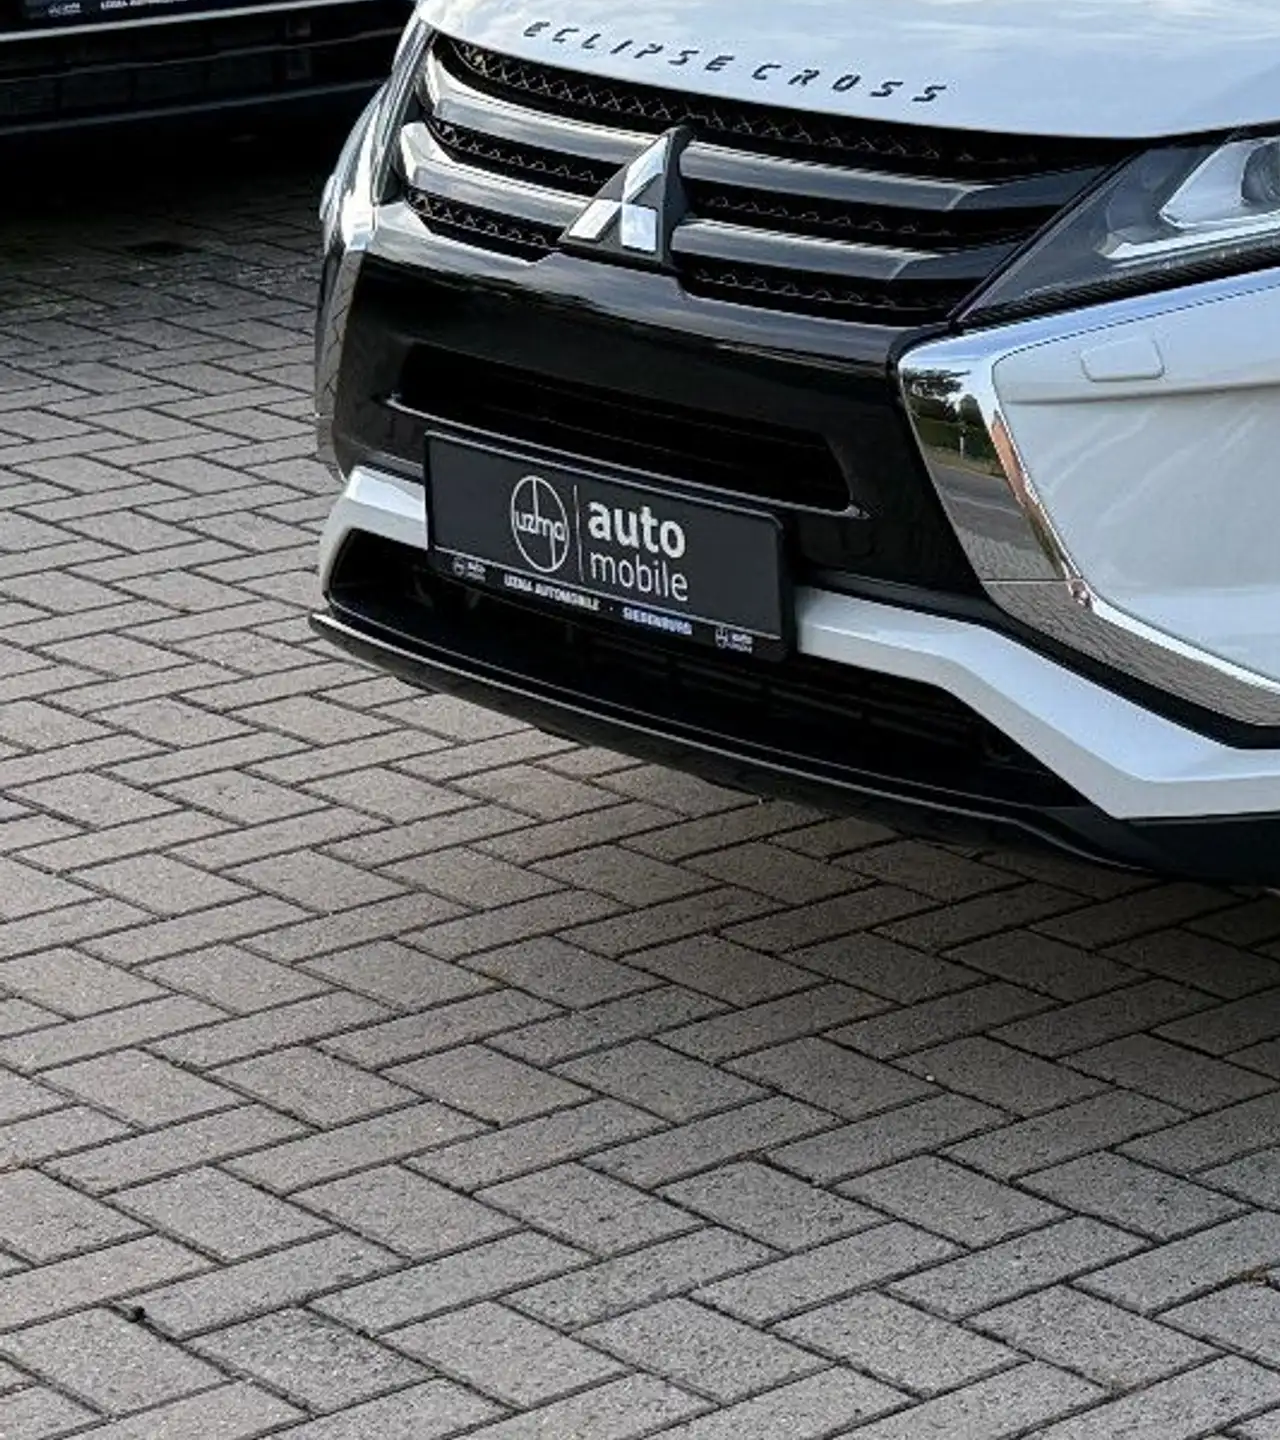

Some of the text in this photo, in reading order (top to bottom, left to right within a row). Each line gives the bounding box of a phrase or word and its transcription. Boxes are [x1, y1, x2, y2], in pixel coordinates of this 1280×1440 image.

[523, 21, 948, 104] ECLIPSE CROSS
[588, 500, 685, 558] auto
[590, 551, 689, 602] mobile
